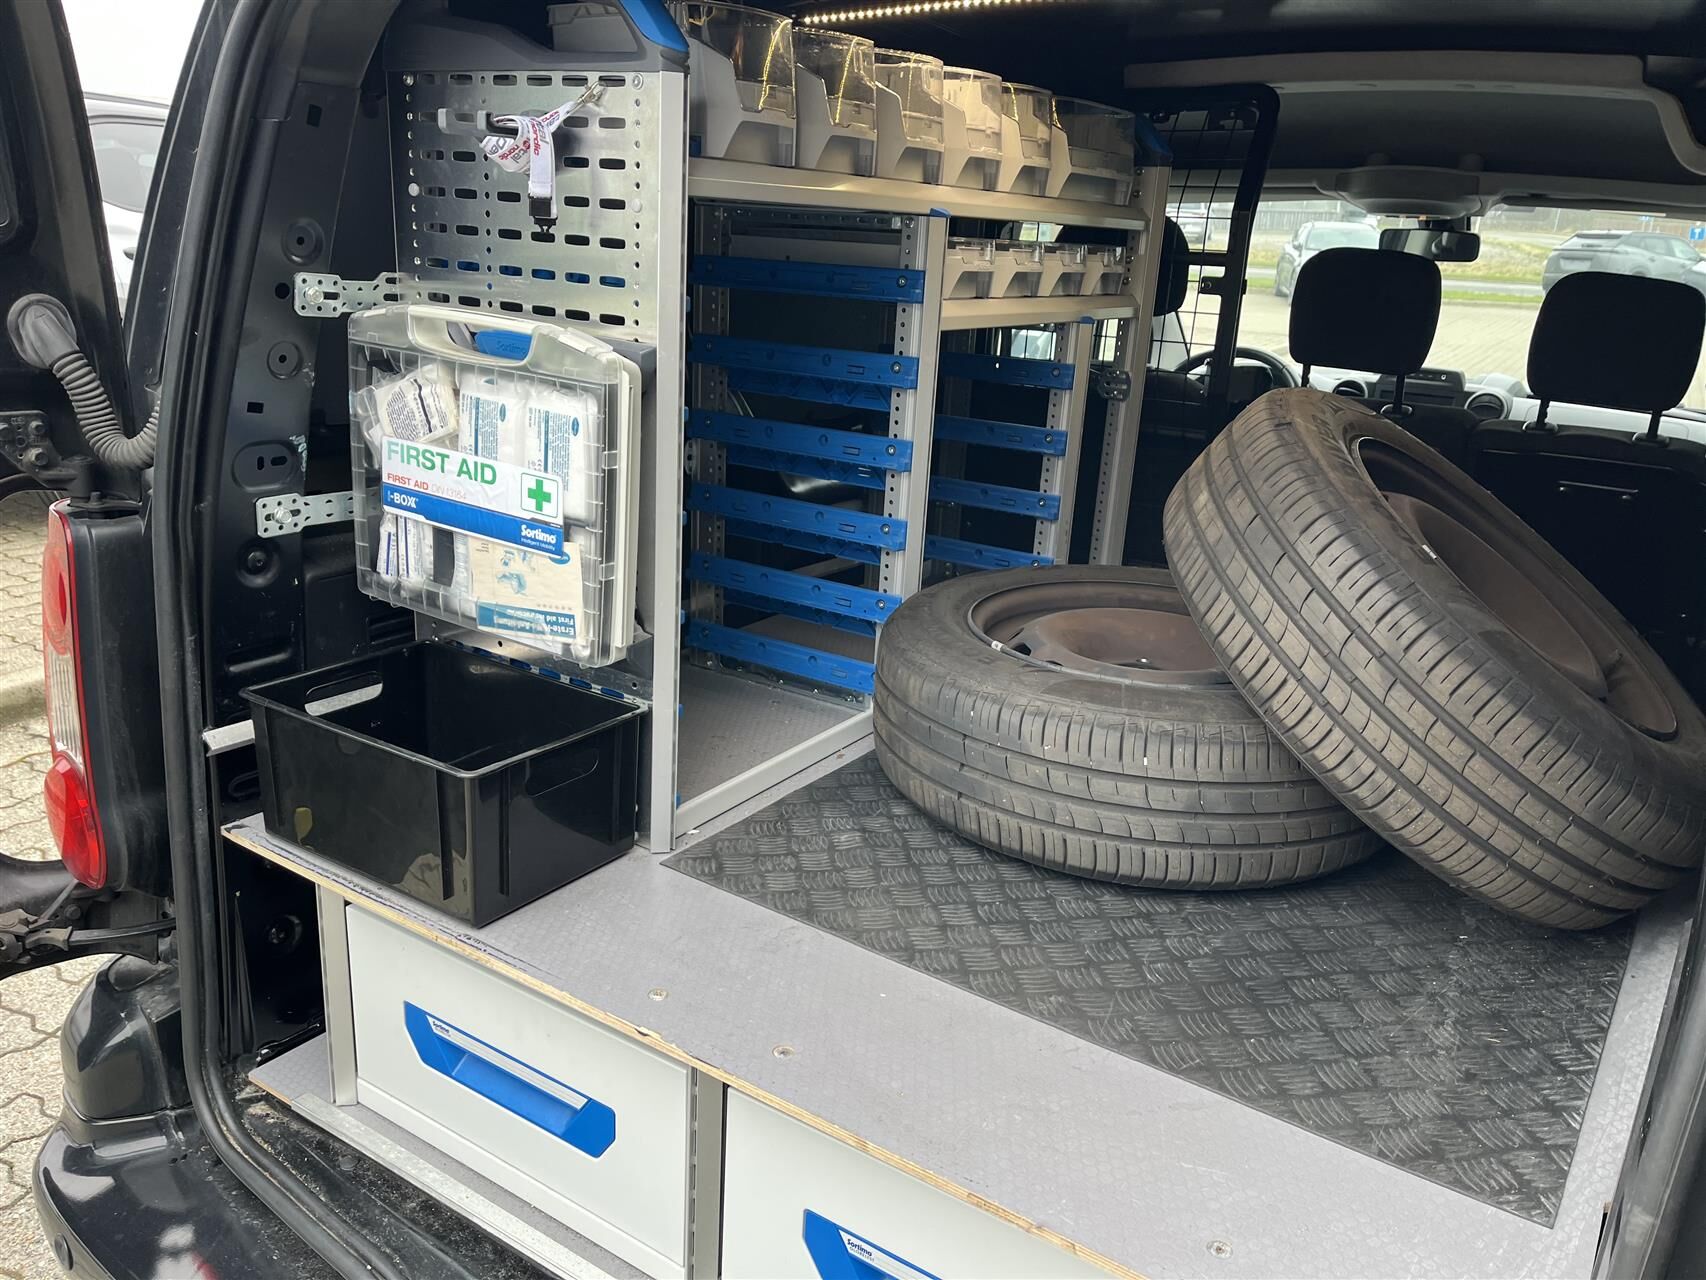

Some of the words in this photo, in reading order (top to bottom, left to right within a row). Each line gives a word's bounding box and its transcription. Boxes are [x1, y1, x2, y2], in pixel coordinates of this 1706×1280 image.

[386, 440, 450, 474] FIRST
[456, 458, 497, 486] AID
[387, 472, 411, 486] FIRST
[414, 479, 429, 491] AID
[520, 524, 557, 544] Sortimo
[847, 1238, 873, 1257] Sortimo
